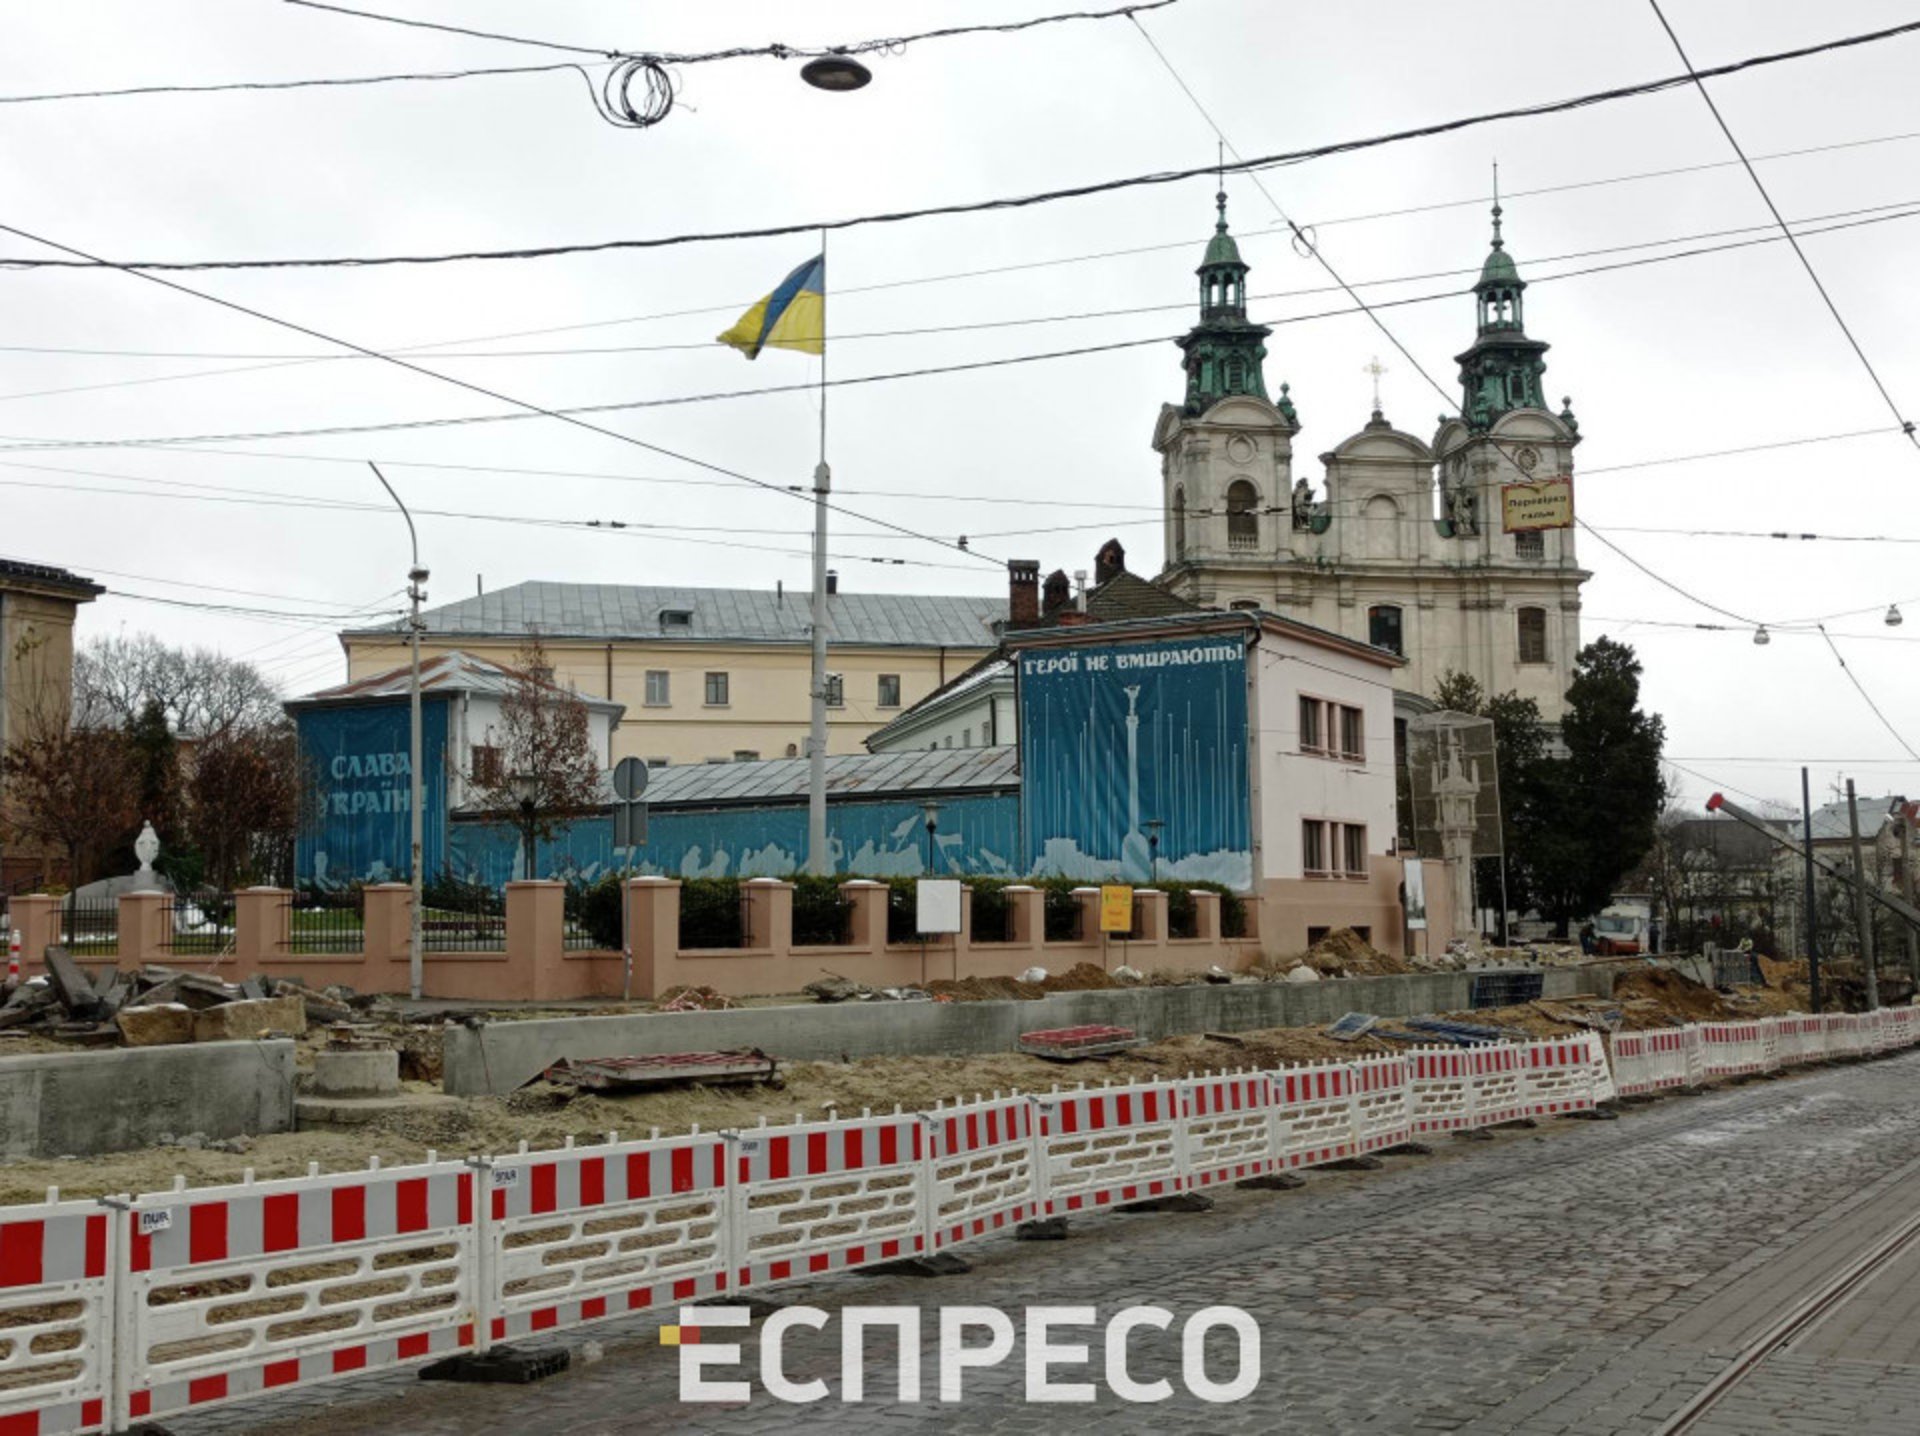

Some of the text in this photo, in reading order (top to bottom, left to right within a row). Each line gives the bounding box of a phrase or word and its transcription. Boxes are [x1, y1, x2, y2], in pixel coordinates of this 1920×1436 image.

[1023, 652, 1079, 675] ГЕРОЇ
[1085, 655, 1109, 672] НЕ
[331, 752, 412, 780] СЛАВА
